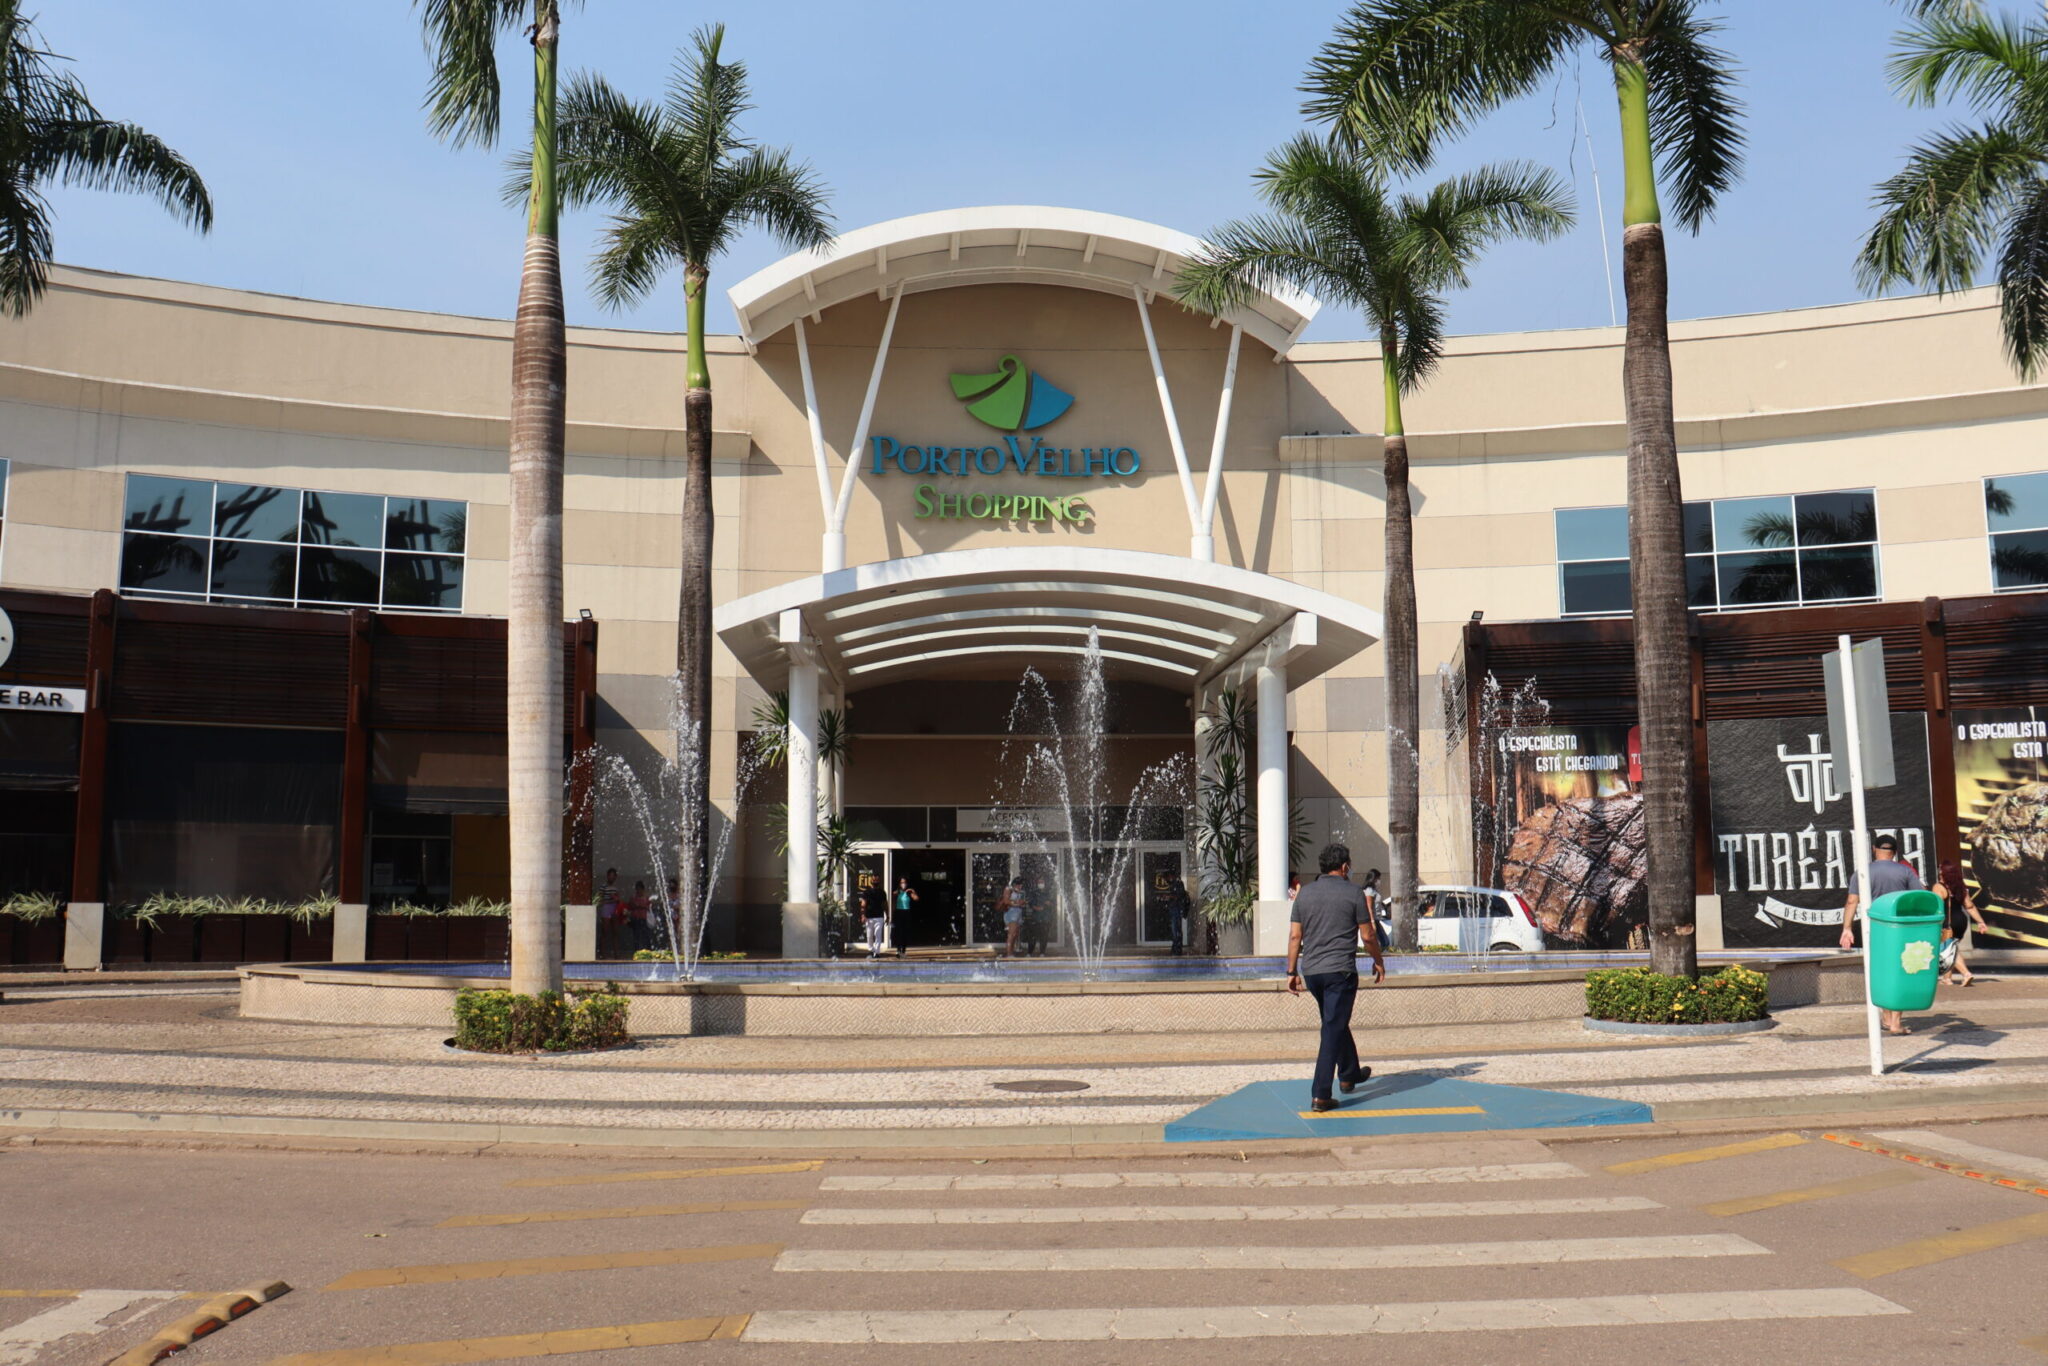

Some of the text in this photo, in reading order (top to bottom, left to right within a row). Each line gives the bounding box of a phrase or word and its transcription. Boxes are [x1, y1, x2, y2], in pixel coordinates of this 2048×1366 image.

[869, 435, 1141, 477] PORTO VELHO
[913, 483, 1089, 521] SHOPPING
[18, 690, 63, 707] BAR
[1957, 720, 2047, 741] O ESPECIALISTA
[1498, 734, 1578, 752] O ESPECIALISTA
[1718, 822, 1929, 892] TORÉAR
[1783, 906, 1826, 923] DESDE
